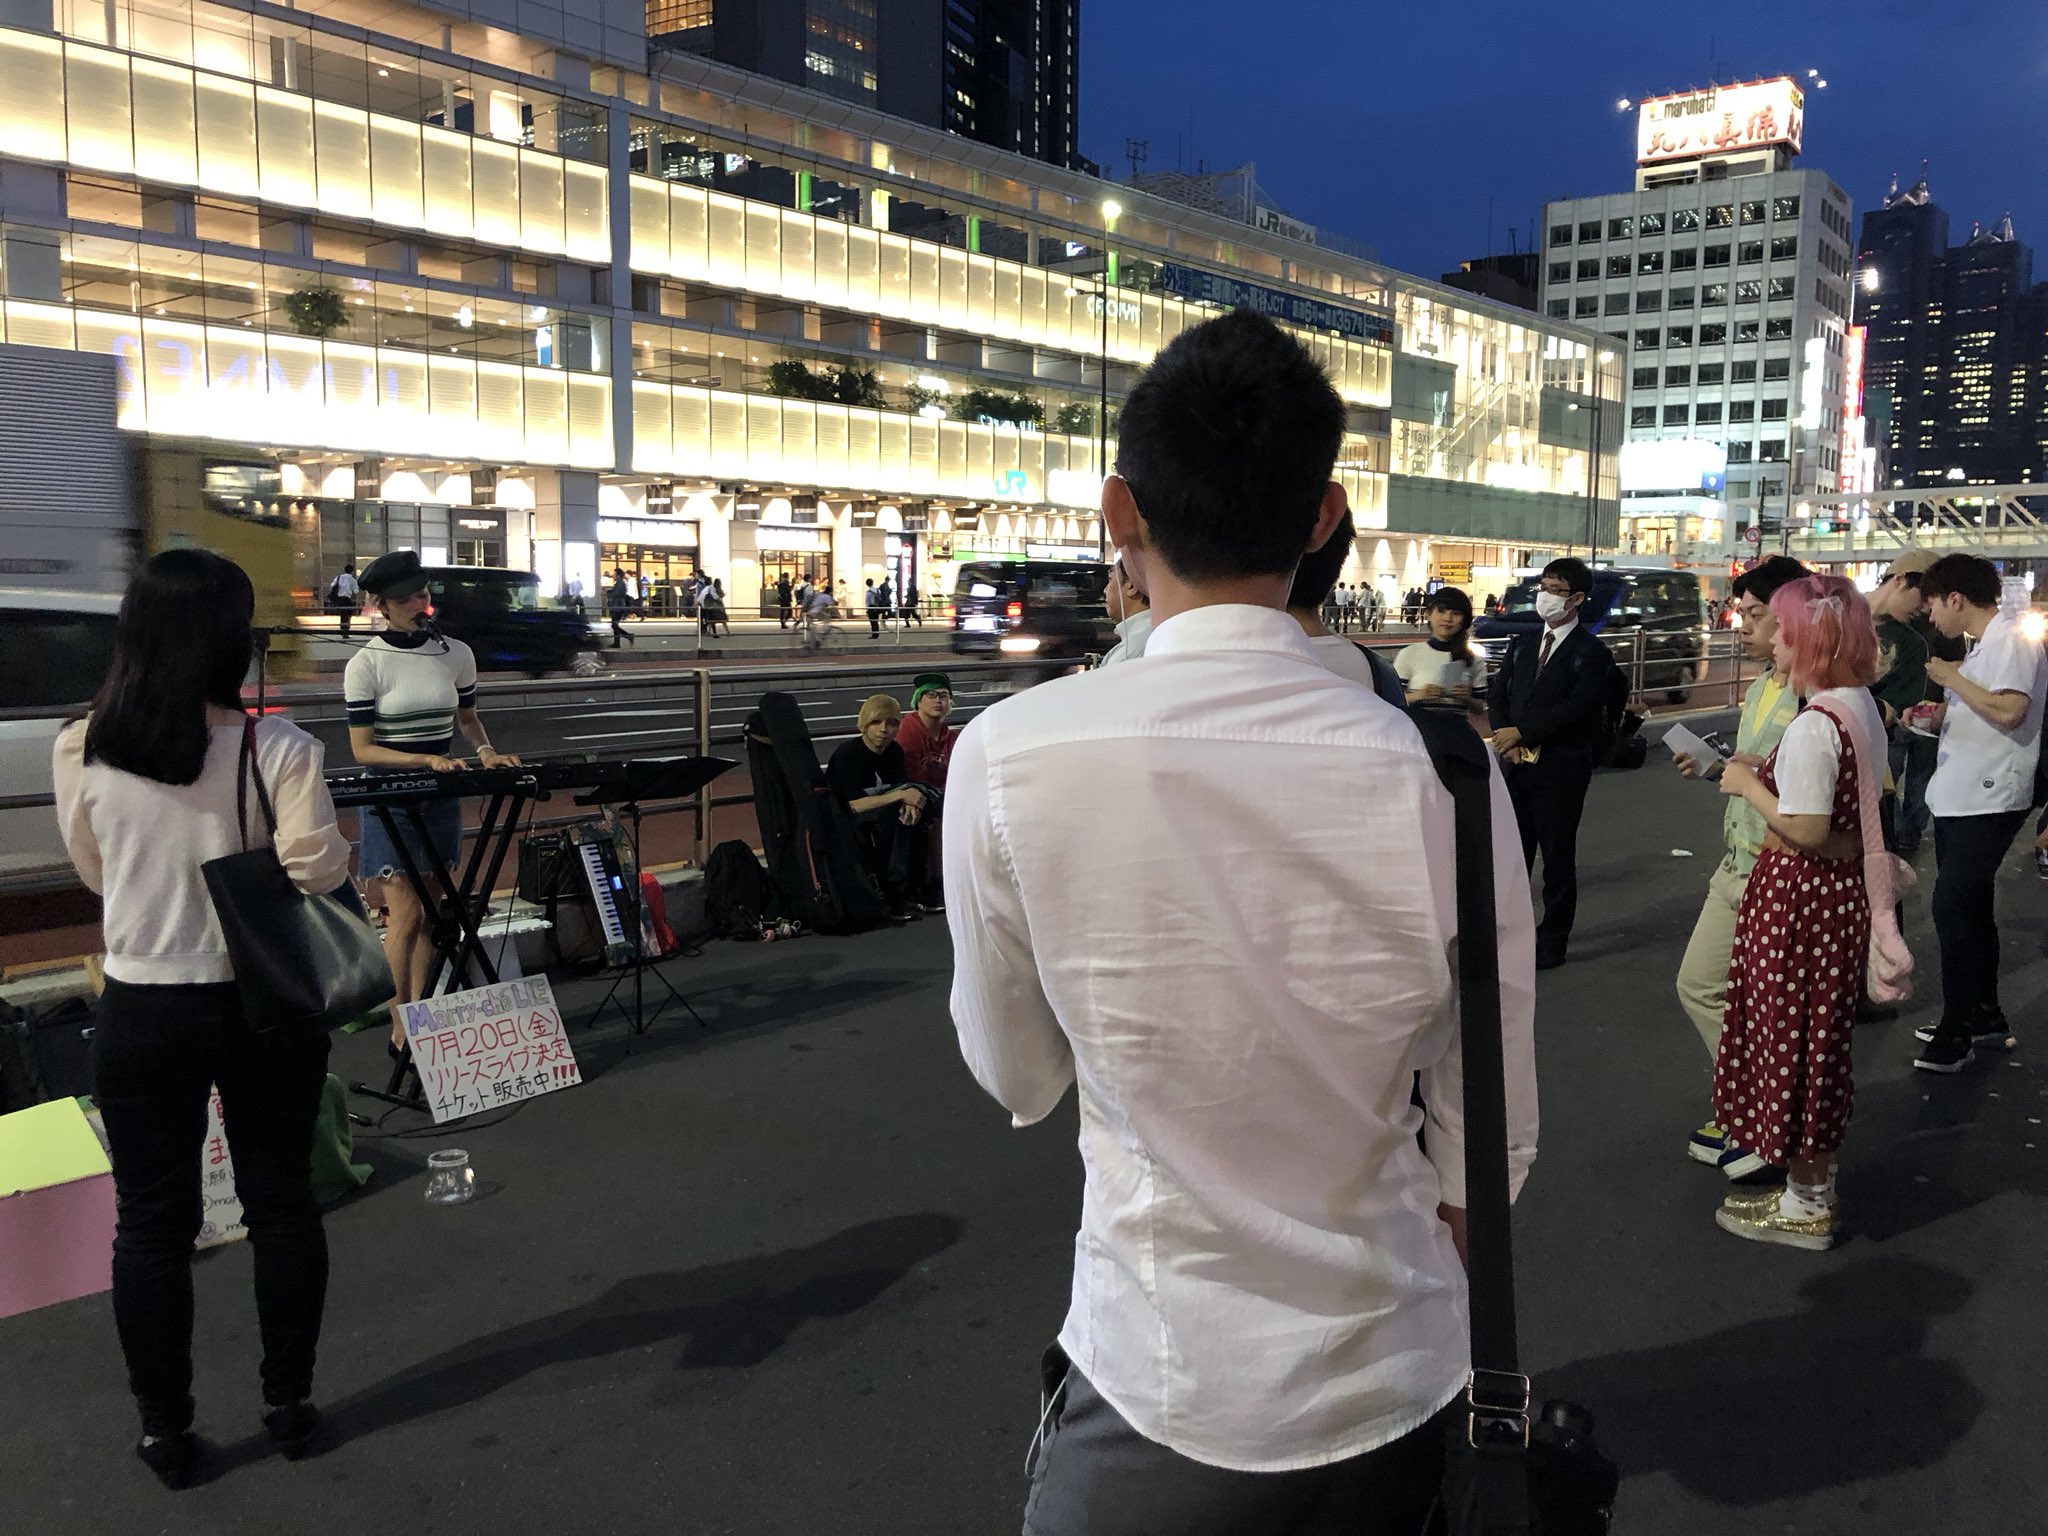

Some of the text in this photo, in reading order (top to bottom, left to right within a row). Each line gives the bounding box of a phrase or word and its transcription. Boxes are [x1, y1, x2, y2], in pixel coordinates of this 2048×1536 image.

[994, 469, 1027, 496] JR
[339, 785, 368, 794] Roland
[511, 978, 551, 1009] LIE
[416, 1008, 561, 1066] 7月20日(金)
[428, 1037, 573, 1095] リリースライブ決定
